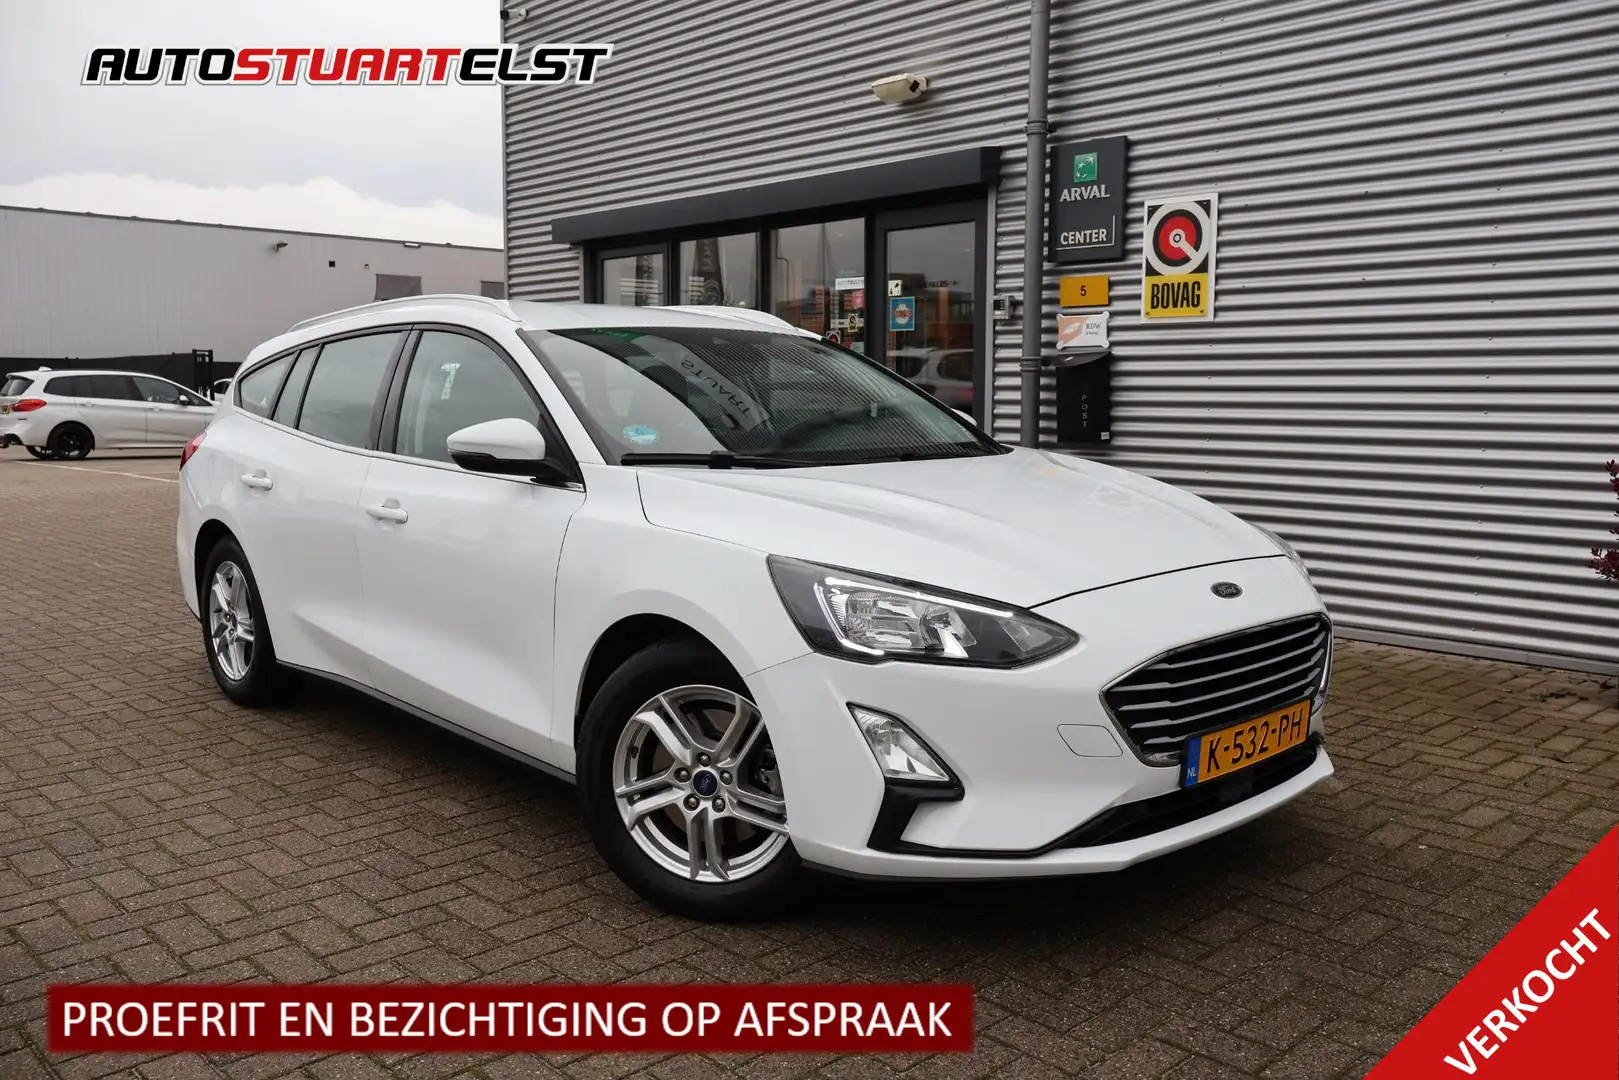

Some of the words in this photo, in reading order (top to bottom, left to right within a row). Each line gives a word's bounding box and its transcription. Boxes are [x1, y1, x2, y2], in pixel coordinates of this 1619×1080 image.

[1060, 184, 1110, 202] ARVAL
[1060, 228, 1107, 246] CENTER
[1079, 285, 1087, 297] 5
[1150, 280, 1201, 310] BOVAG
[1206, 706, 1304, 774] K-532-PH
[1186, 766, 1197, 779] NL
